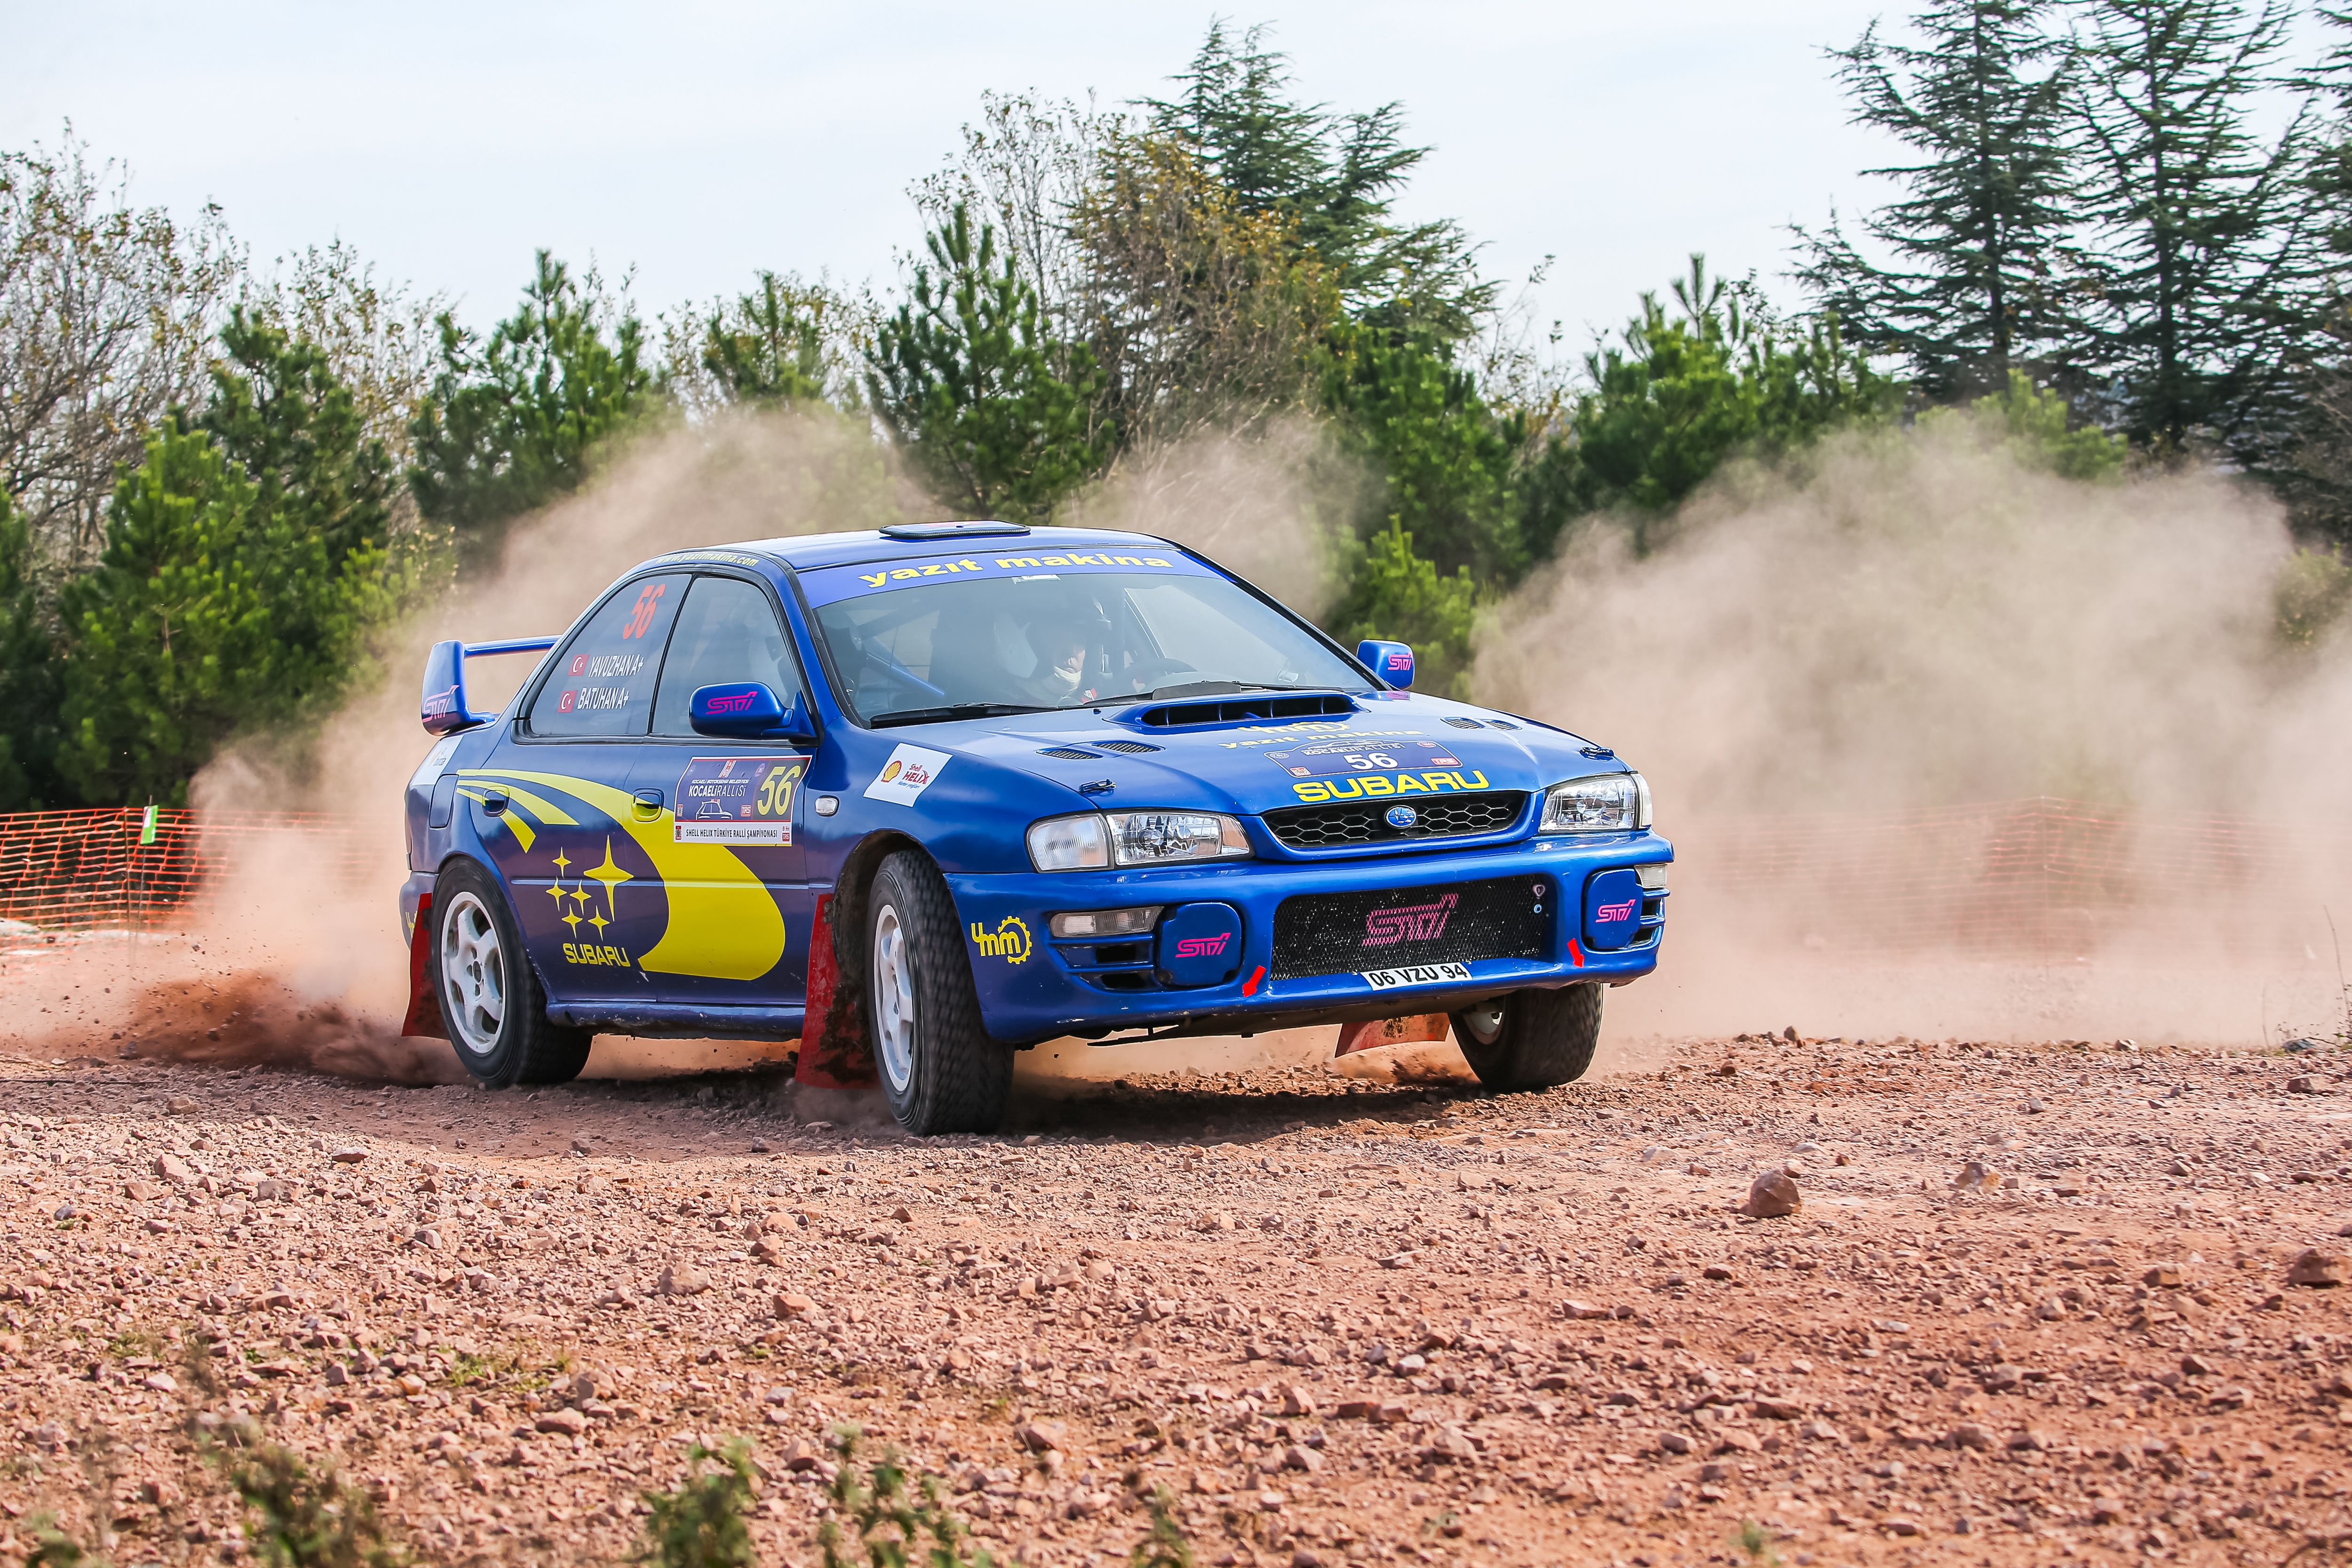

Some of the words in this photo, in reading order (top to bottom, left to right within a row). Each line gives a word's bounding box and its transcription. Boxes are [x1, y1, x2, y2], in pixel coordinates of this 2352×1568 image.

[994, 553, 1175, 569] makina
[623, 583, 666, 639] 56
[588, 654, 635, 678] YAVUZHAN
[577, 687, 620, 709] BATUHAN
[1306, 729, 1424, 741] makina
[1343, 752, 1399, 770] 56
[902, 770, 930, 784] HELIX
[1292, 770, 1490, 802] SUBARU
[757, 765, 801, 815] 56
[714, 828, 732, 837] TÜRKİYE
[733, 828, 746, 837] RALLİ
[747, 828, 778, 839] ŞAMPİYONASI
[563, 942, 631, 967] SUBARU
[1368, 970, 1394, 987] 06
[1394, 966, 1439, 983] VZU
[1443, 963, 1468, 979] 94
